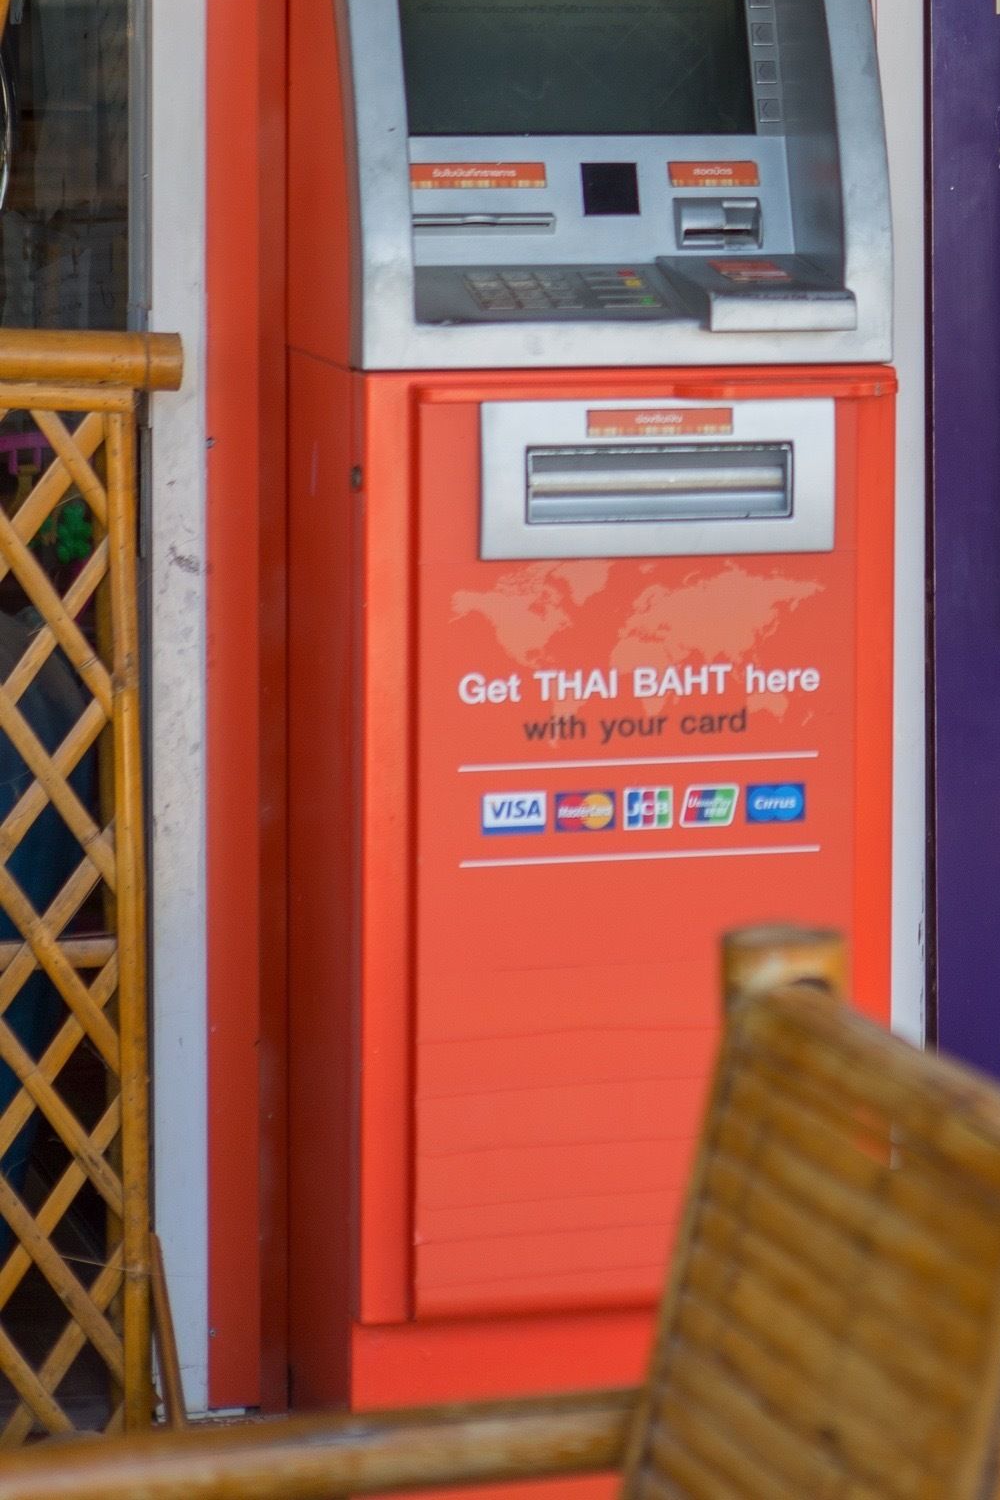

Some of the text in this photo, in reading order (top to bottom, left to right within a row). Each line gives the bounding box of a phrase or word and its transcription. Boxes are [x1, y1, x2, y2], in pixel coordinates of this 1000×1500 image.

[458, 664, 821, 705] Get THAI BAHT here
[523, 708, 748, 744] with your card
[489, 798, 541, 819] VISA
[626, 801, 669, 817] JCB
[754, 797, 796, 811] Cirrus
